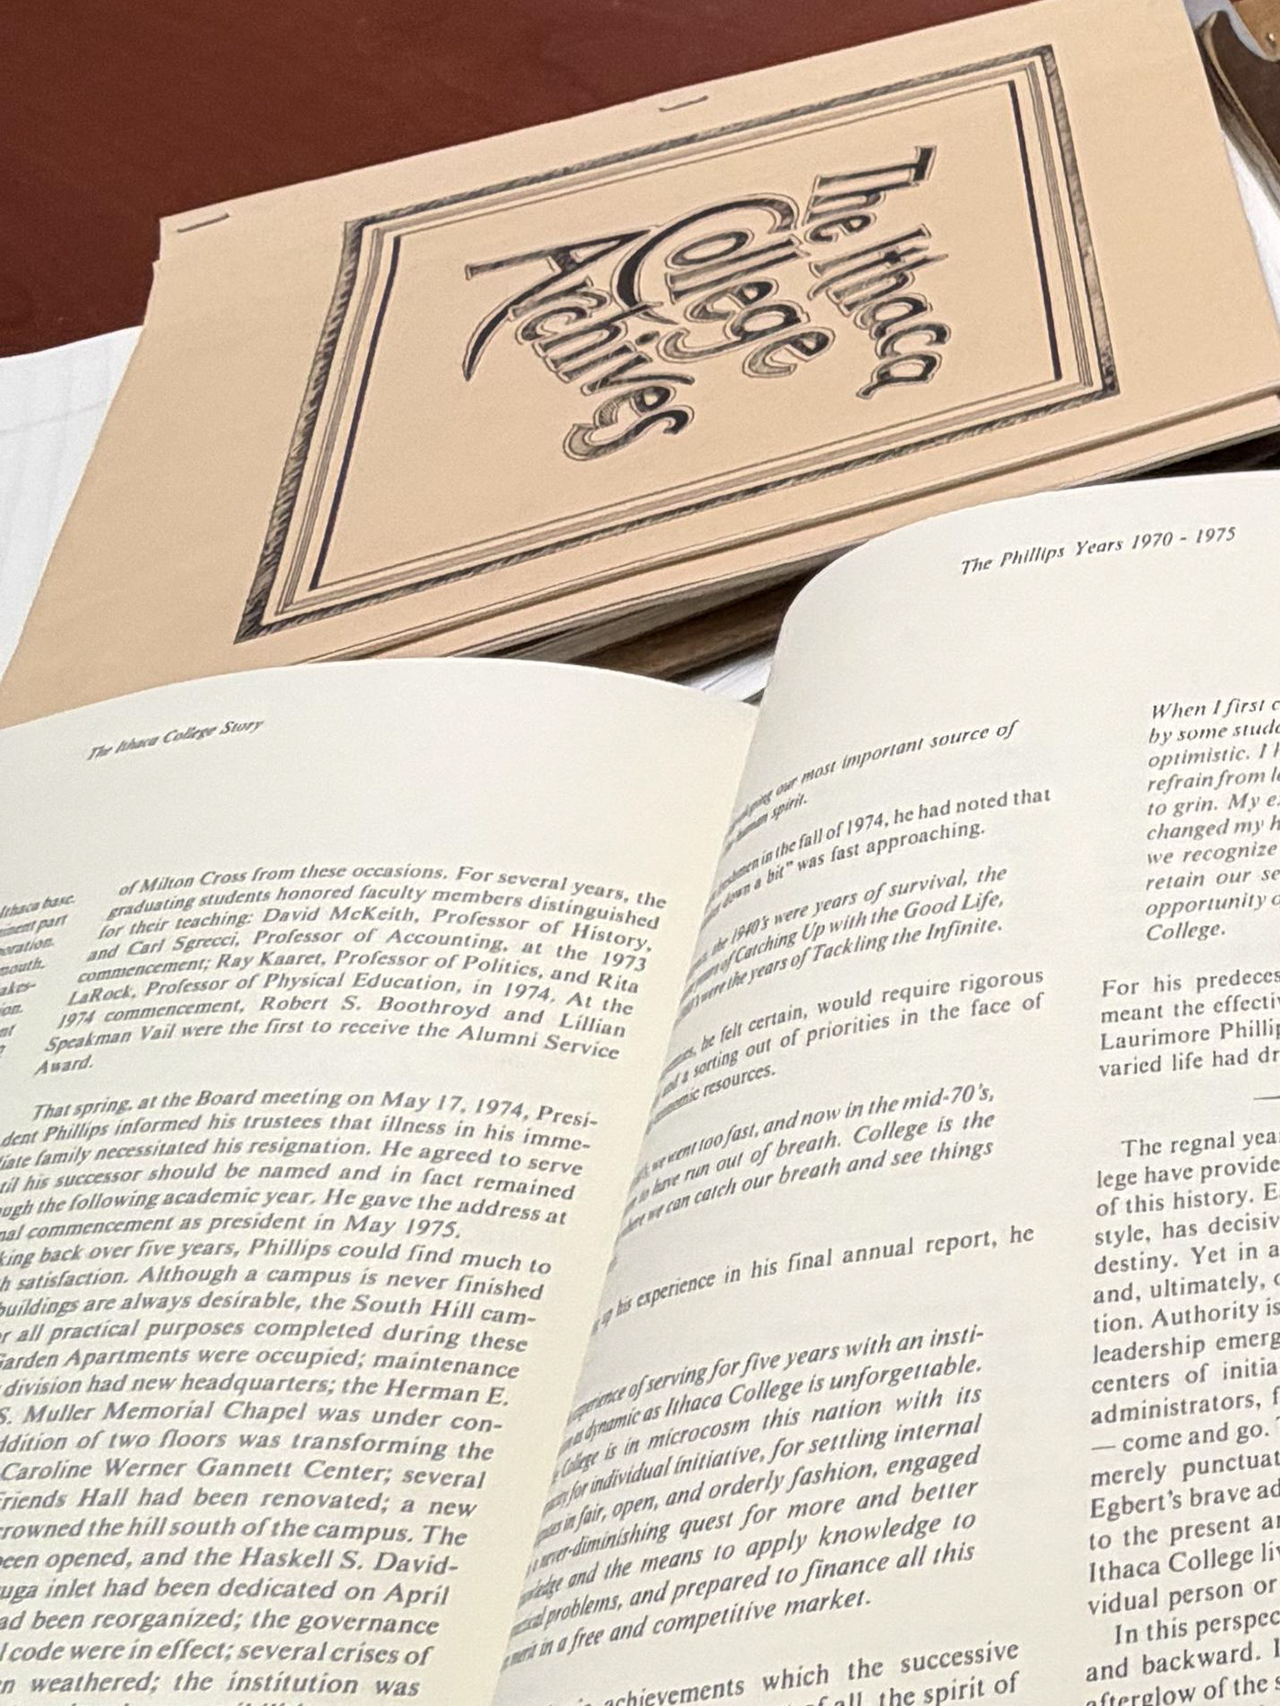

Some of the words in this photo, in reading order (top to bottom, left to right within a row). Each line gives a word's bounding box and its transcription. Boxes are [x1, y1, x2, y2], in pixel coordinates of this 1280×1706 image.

[800, 145, 937, 244] The
[611, 192, 837, 378] College
[808, 224, 951, 400] Ithaca
[463, 229, 695, 463] Archives
[962, 557, 994, 576] The
[1000, 547, 1065, 568] Phillips
[1076, 540, 1124, 557] Years
[1132, 531, 1174, 550] 1970
[1196, 527, 1237, 544] 1975
[1153, 702, 1207, 720] When
[1226, 698, 1266, 719] first
[56, 1010, 97, 1030] 1974
[104, 999, 245, 1027] commencement,
[259, 996, 329, 1012] Robert
[340, 995, 362, 1011] S.
[377, 996, 491, 1020] Boothroyd
[503, 1010, 545, 1025] and
[558, 1013, 626, 1038] Lillian
[1102, 979, 1140, 998] For
[1154, 974, 1182, 993] his
